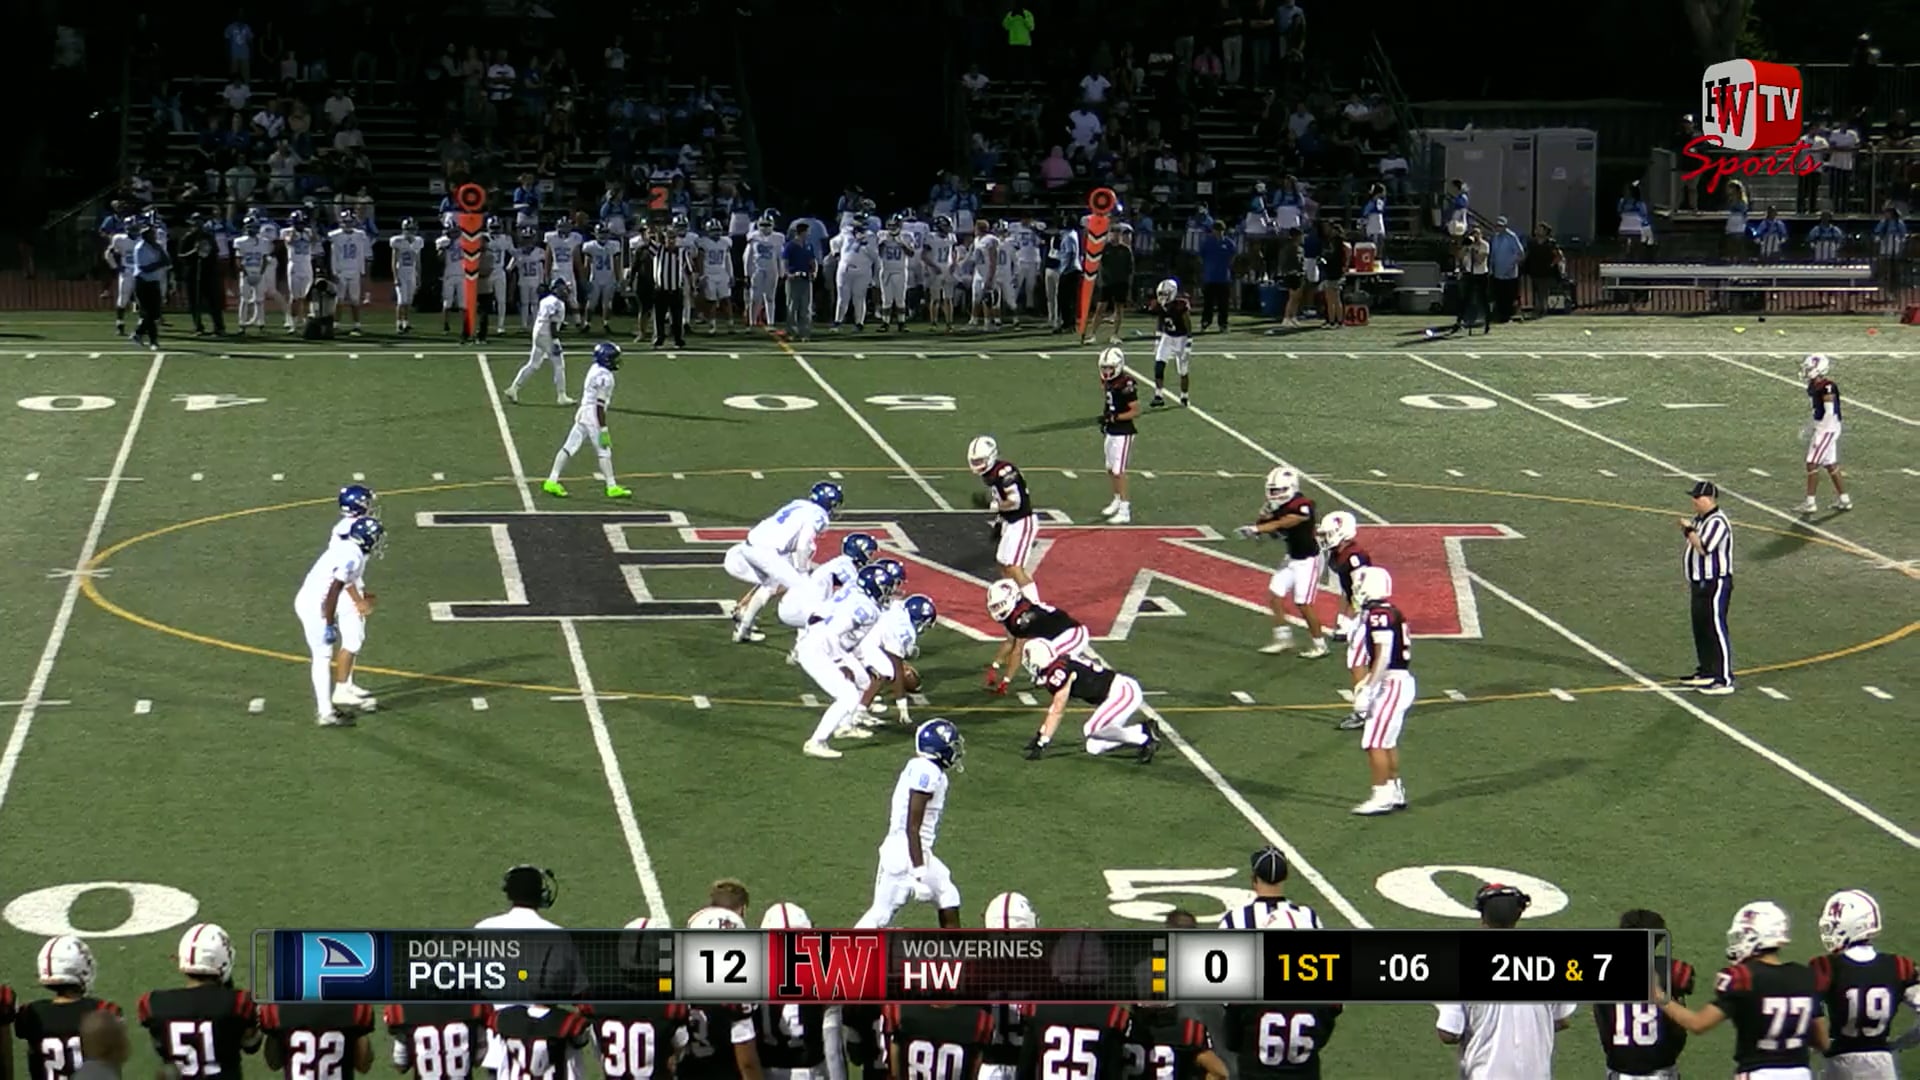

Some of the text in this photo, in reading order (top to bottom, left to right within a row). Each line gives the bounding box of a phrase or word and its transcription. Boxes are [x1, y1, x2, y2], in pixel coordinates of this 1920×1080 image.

[649, 186, 668, 209] 2
[596, 255, 611, 271] 34
[1347, 306, 1367, 323] 40
[1370, 613, 1388, 629] 54
[1049, 667, 1067, 687] 50
[1612, 1003, 1658, 1046] 18
[1756, 997, 1812, 1049] 77
[1841, 987, 1891, 1038] 19
[169, 1021, 222, 1076] 51
[290, 1030, 345, 1080] 22
[414, 1022, 469, 1080] 88
[601, 1020, 655, 1077] 30
[908, 1039, 963, 1080] 80
[1043, 1025, 1100, 1080] 25
[1258, 1012, 1316, 1066] 66
